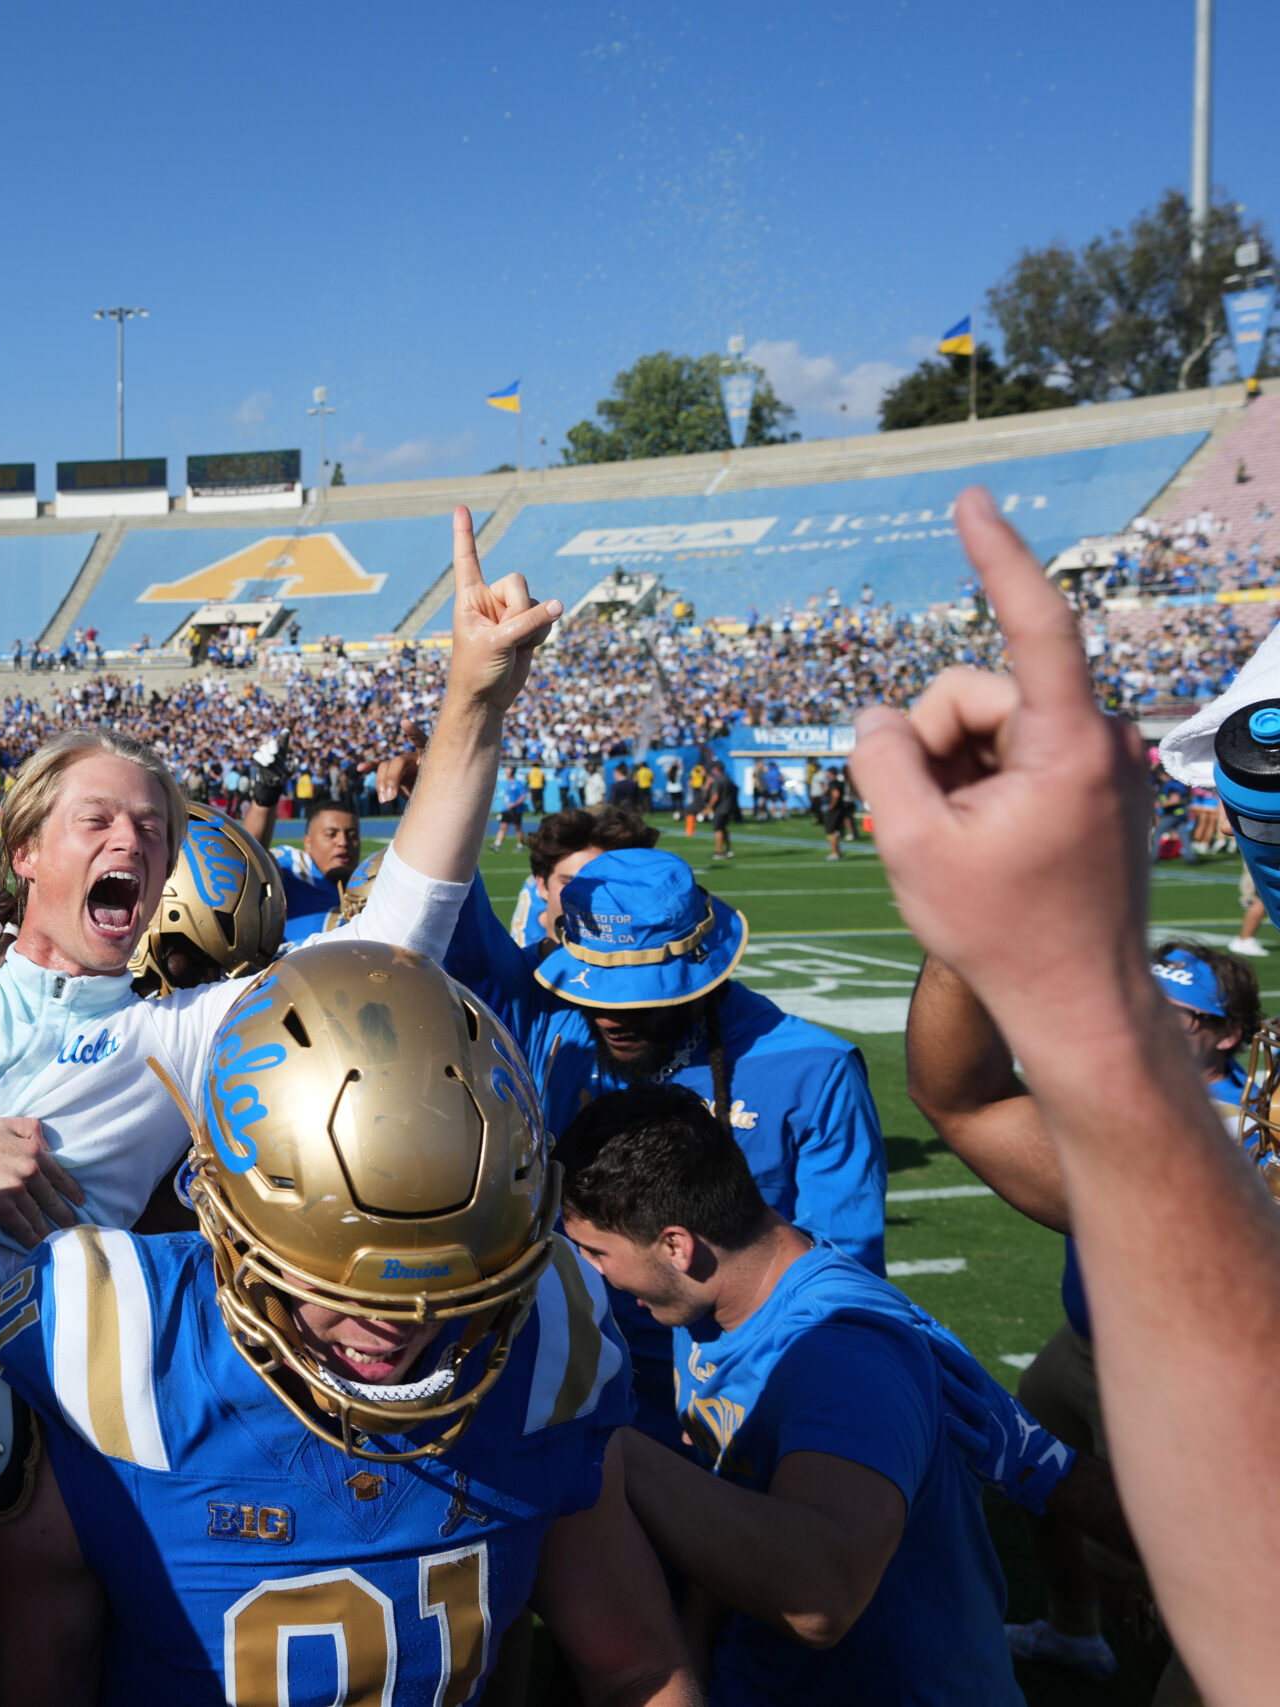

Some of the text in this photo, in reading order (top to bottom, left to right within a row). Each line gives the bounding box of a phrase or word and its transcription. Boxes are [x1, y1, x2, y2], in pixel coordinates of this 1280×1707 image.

[792, 494, 1047, 536] Healh
[753, 727, 829, 745] WESCOM
[609, 914, 632, 924] FOR
[618, 934, 635, 944] CA
[57, 1028, 121, 1065] Ucla
[203, 974, 288, 1176] Ucla
[379, 1258, 451, 1279] Bruins
